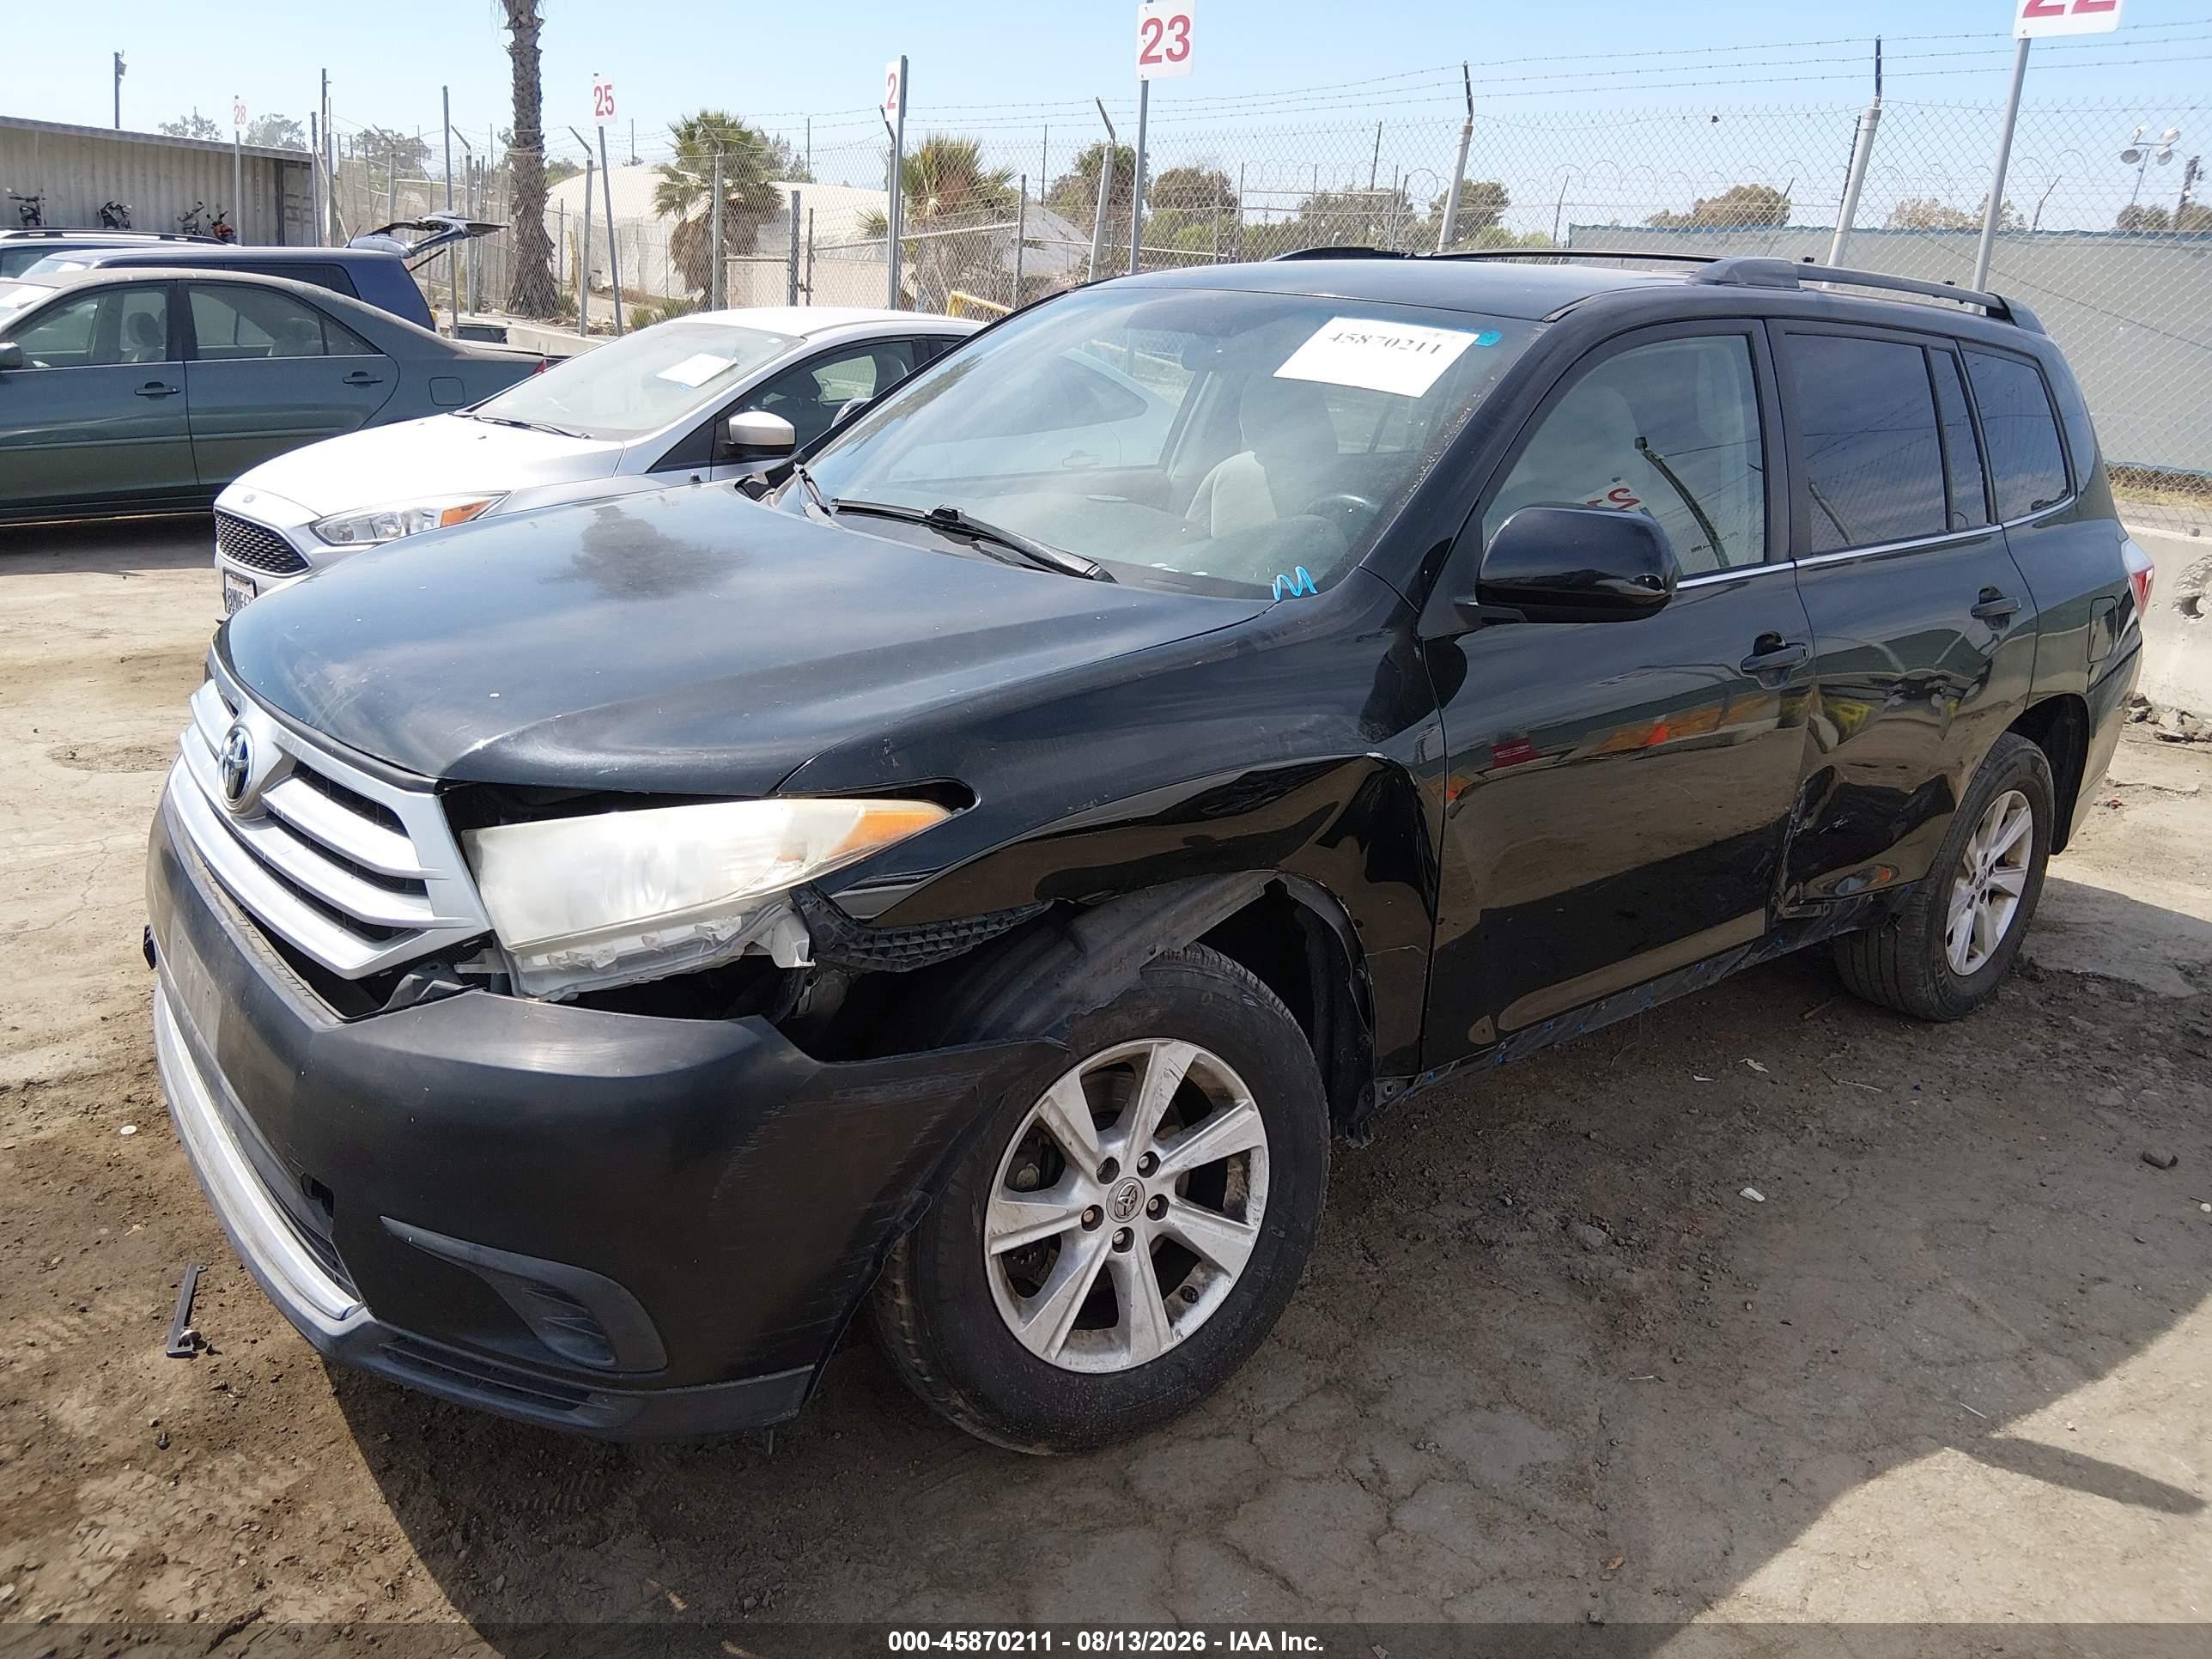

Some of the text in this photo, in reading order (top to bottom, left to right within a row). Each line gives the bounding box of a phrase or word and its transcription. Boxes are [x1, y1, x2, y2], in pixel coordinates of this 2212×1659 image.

[1139, 15, 1190, 65] 23
[594, 84, 615, 117] 25
[887, 73, 900, 110] 2
[234, 105, 246, 125] 28
[1328, 332, 1443, 355] 45870211
